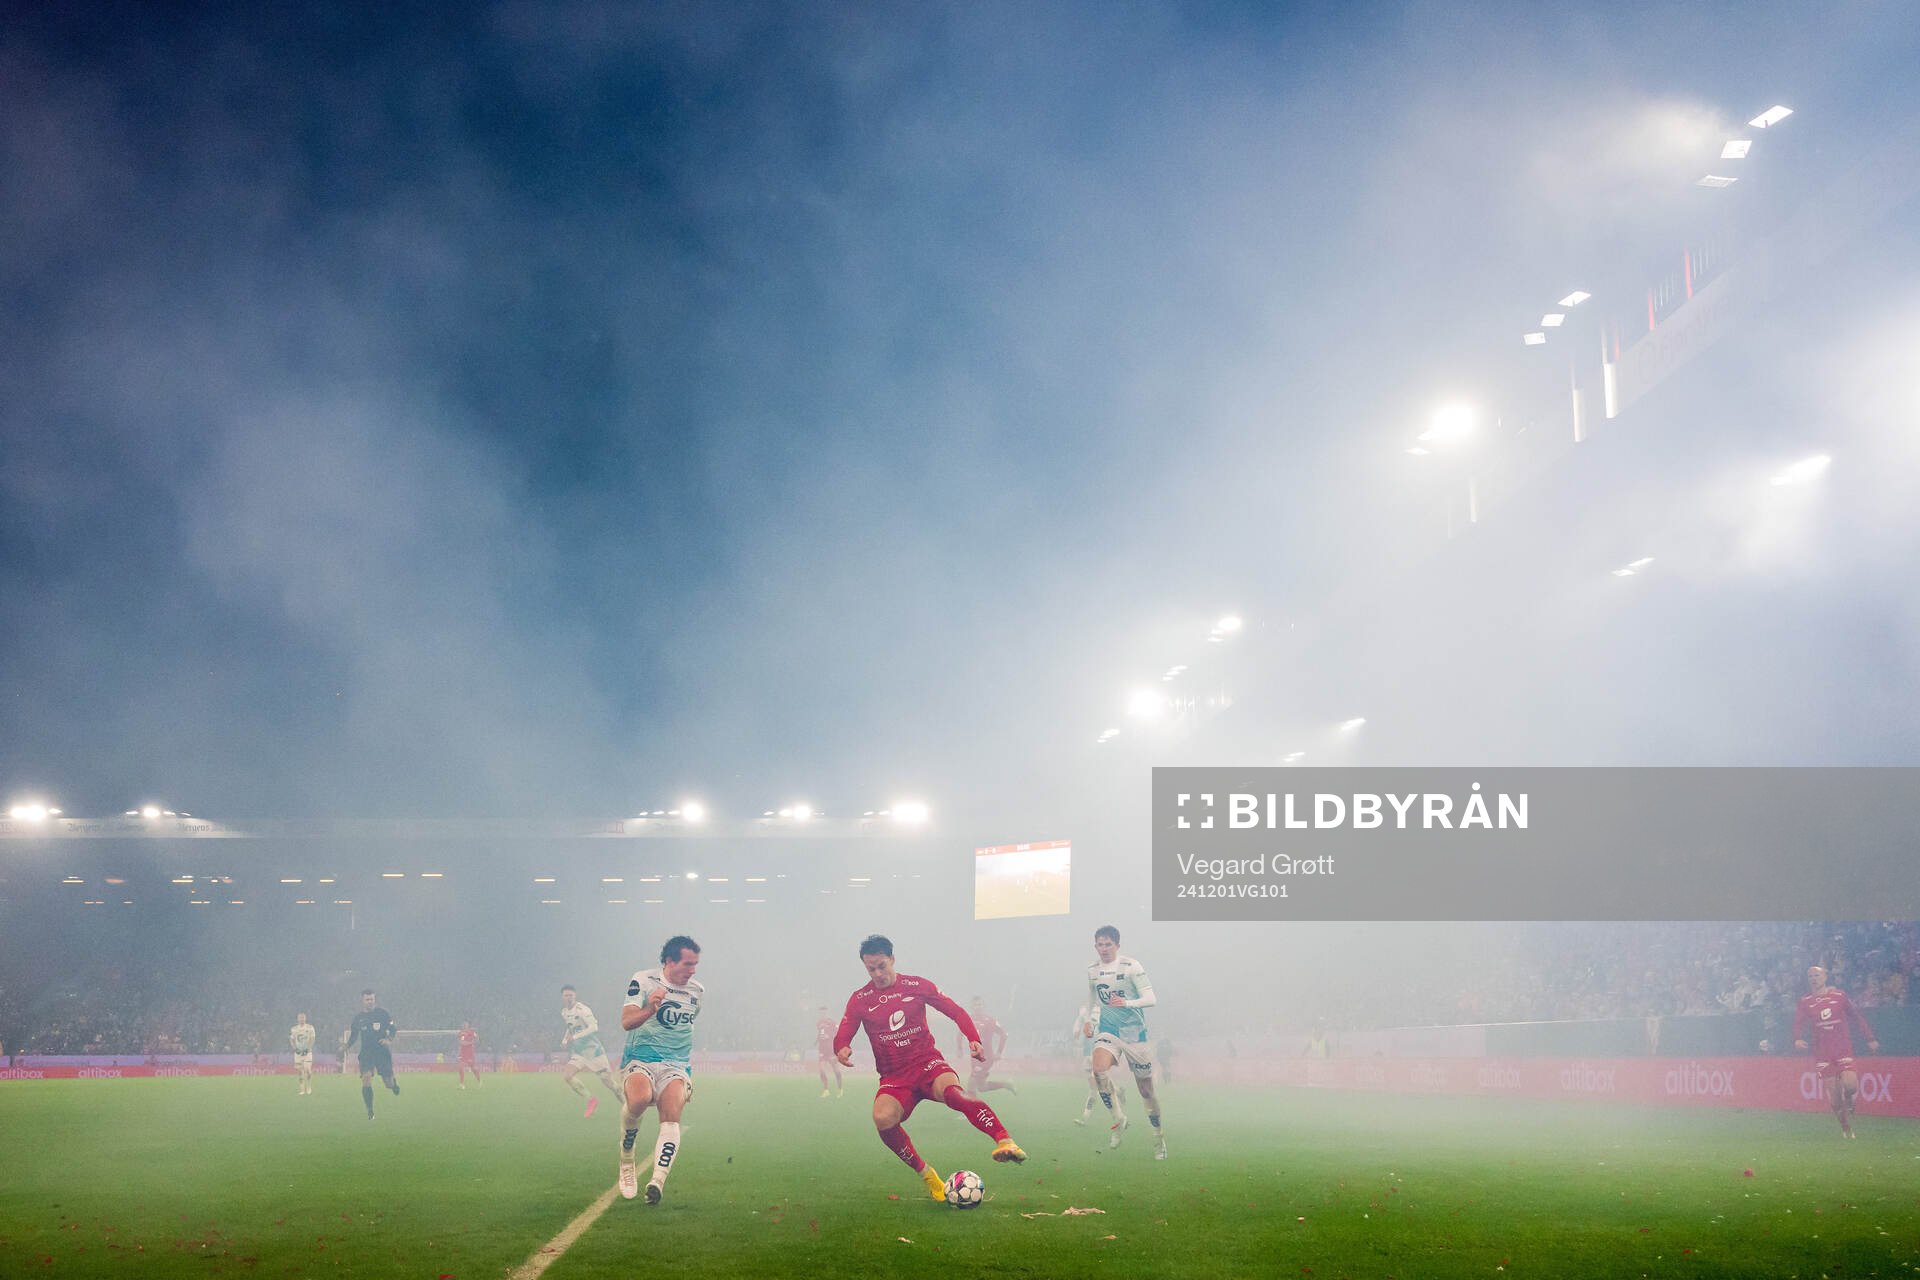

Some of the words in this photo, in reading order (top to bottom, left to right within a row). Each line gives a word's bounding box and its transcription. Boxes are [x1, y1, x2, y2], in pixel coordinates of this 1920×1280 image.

[880, 1026, 922, 1042] Sparebanken
[894, 1039, 912, 1048] Vest
[0, 1067, 45, 1080] altibox
[78, 1066, 122, 1078] altibox
[1664, 1061, 1735, 1096] altibox
[1800, 1070, 1894, 1103] alox
